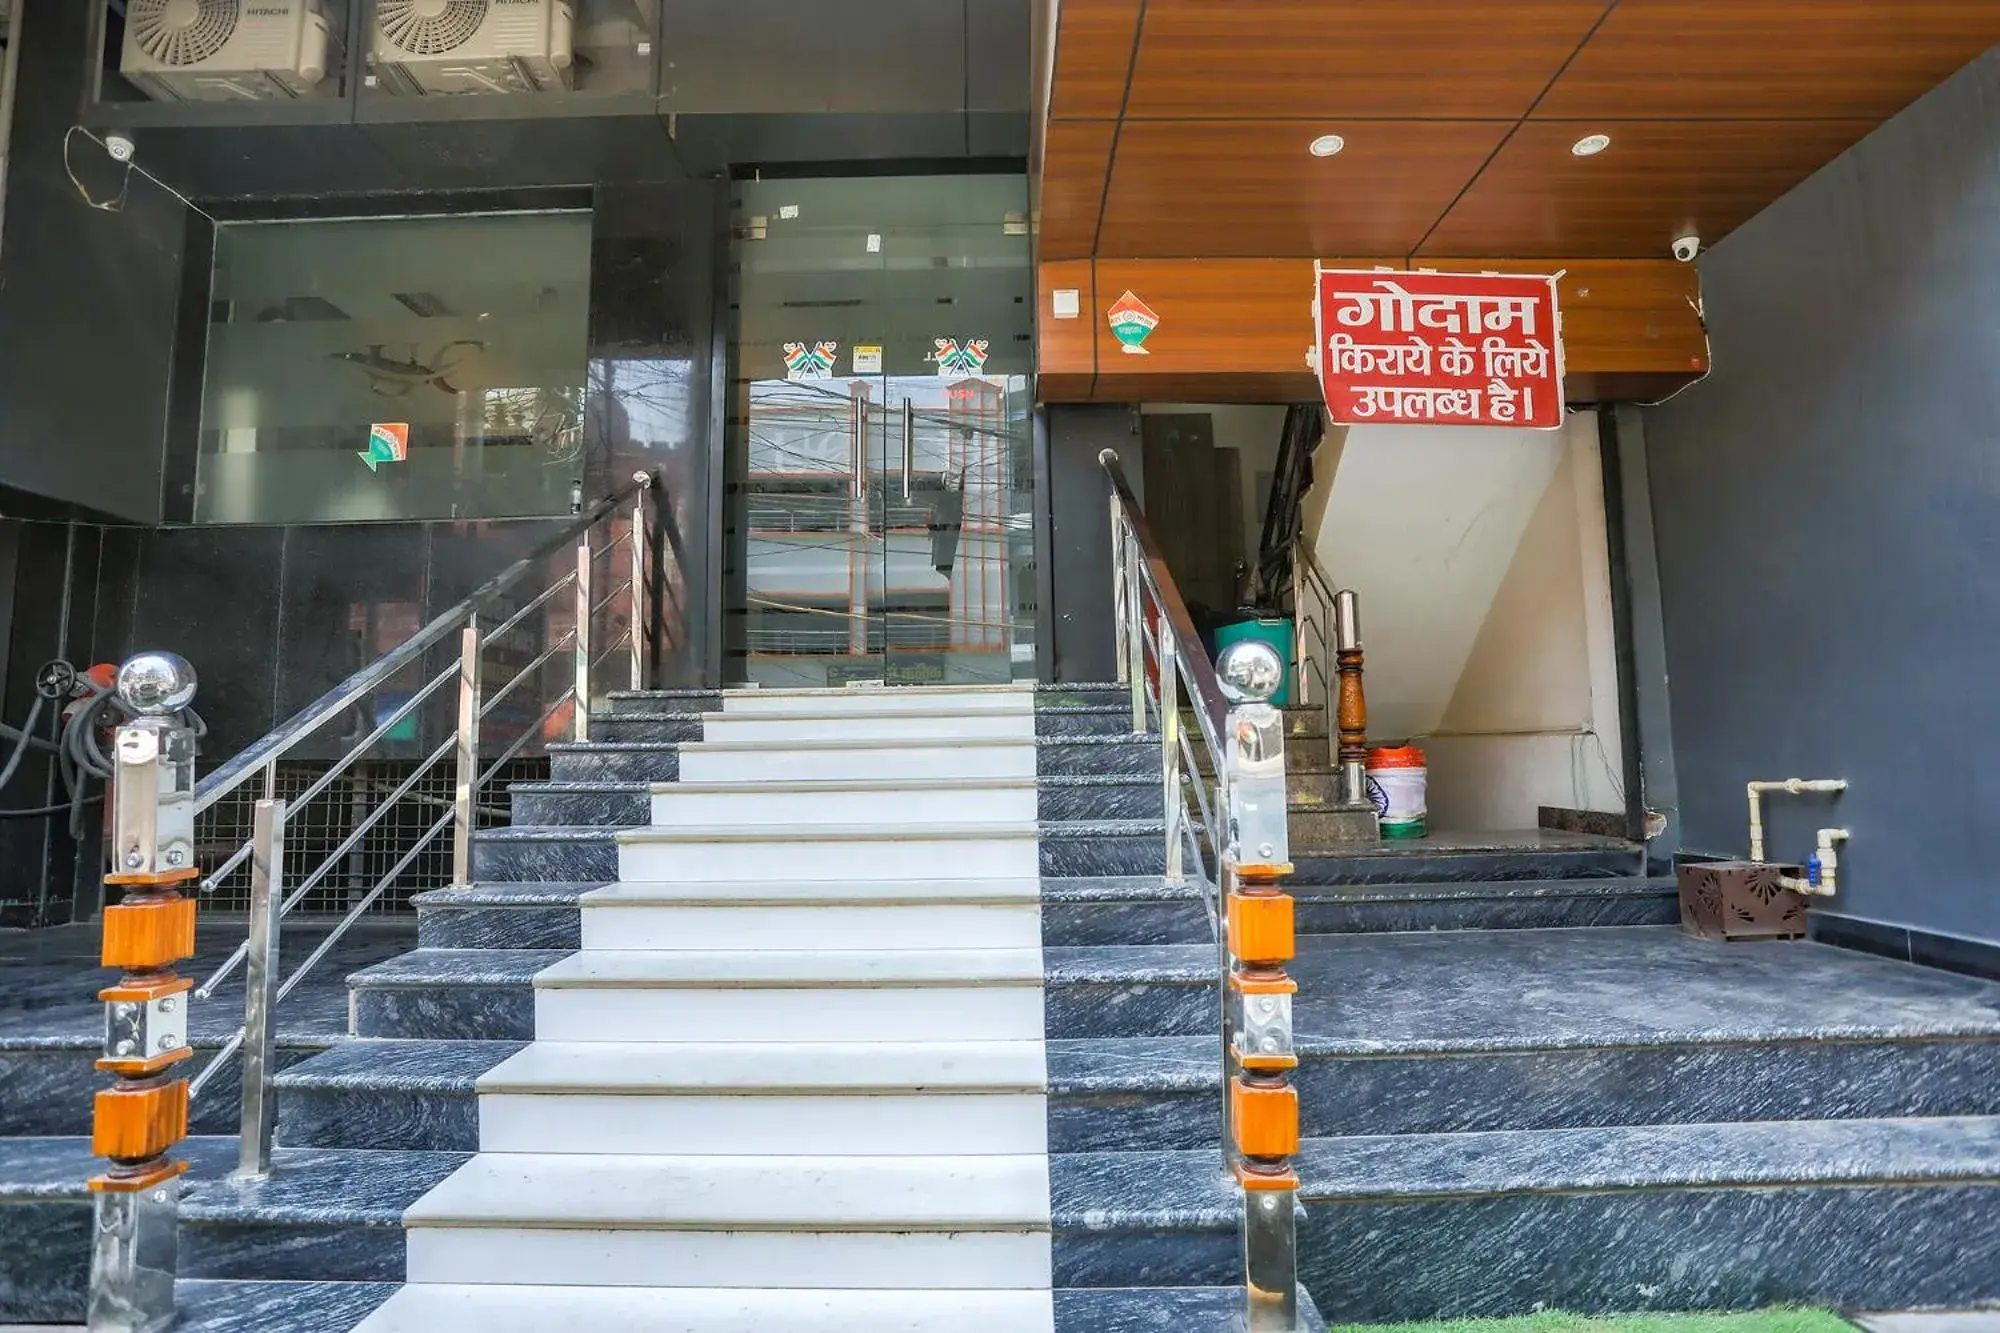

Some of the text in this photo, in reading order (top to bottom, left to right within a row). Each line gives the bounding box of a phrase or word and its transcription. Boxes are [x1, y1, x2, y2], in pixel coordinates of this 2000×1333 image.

[1333, 280, 1540, 335] गोदाम
[1329, 333, 1550, 379] किराये के लिये
[1350, 386, 1482, 420] उपलब्ध
